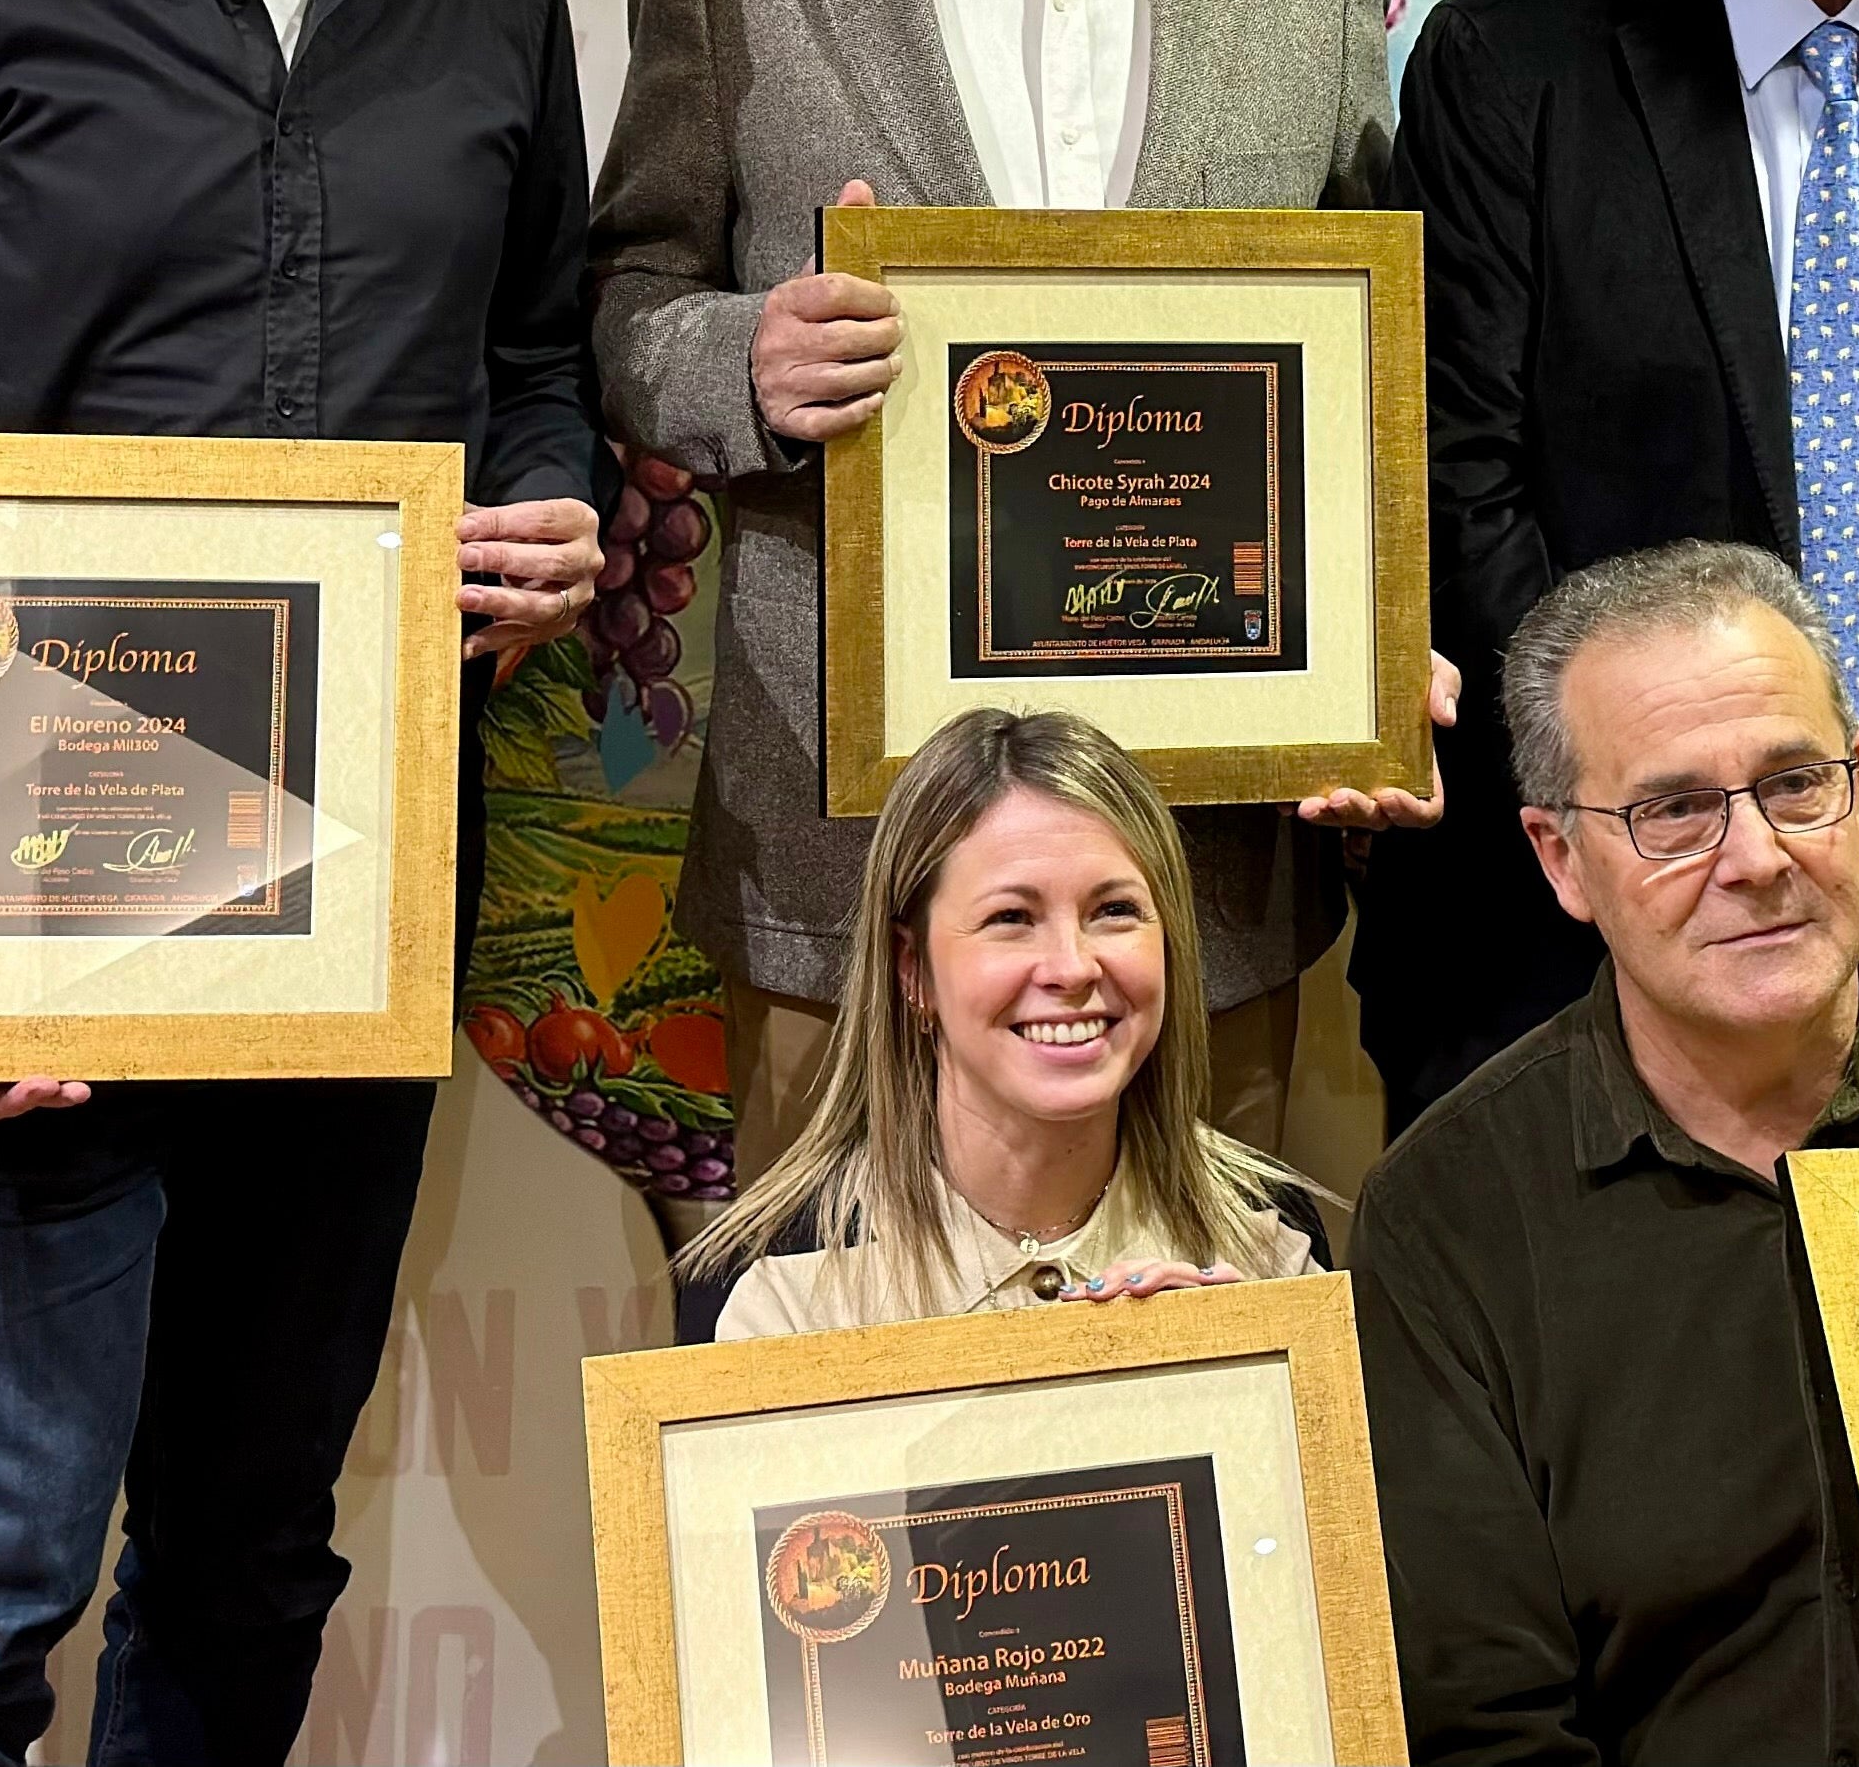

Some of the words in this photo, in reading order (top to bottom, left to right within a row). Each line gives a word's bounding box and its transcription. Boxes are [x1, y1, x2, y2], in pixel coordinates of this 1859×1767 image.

[1061, 395, 1204, 450] Diploma
[1048, 473, 1114, 490] Chicote
[1116, 473, 1165, 494] Syrah
[1168, 473, 1212, 490] 2024
[1080, 494, 1110, 510] Pago
[1112, 494, 1127, 507] de
[1129, 495, 1182, 508] Almaraes
[1064, 536, 1093, 549] Torre
[1095, 536, 1110, 548] de
[1112, 536, 1123, 548] la
[1124, 536, 1150, 548] Vela
[1151, 536, 1166, 548] de
[1168, 536, 1198, 549] Plata
[30, 632, 198, 690] Diploma
[30, 716, 47, 734] El
[53, 718, 132, 734] Moreno
[137, 717, 187, 734] 2024
[58, 739, 110, 755] Bodega
[26, 783, 62, 797] Torre
[64, 783, 82, 797] de
[84, 783, 97, 796] la
[99, 783, 128, 797] Vela
[130, 783, 148, 796] de
[151, 783, 185, 797] Plata
[906, 1544, 1091, 1621] Diploma
[898, 1652, 990, 1680] Muñana
[994, 1644, 1046, 1672] Rojo
[1050, 1636, 1106, 1661] 2022
[944, 1676, 1002, 1697] Bodega
[1004, 1670, 1067, 1689] Muñana
[925, 1727, 964, 1745] Torre
[968, 1724, 986, 1740] de
[990, 1722, 1003, 1737] la
[1004, 1718, 1039, 1735] Vela
[1041, 1715, 1060, 1730] de
[1063, 1711, 1091, 1728] Oro
